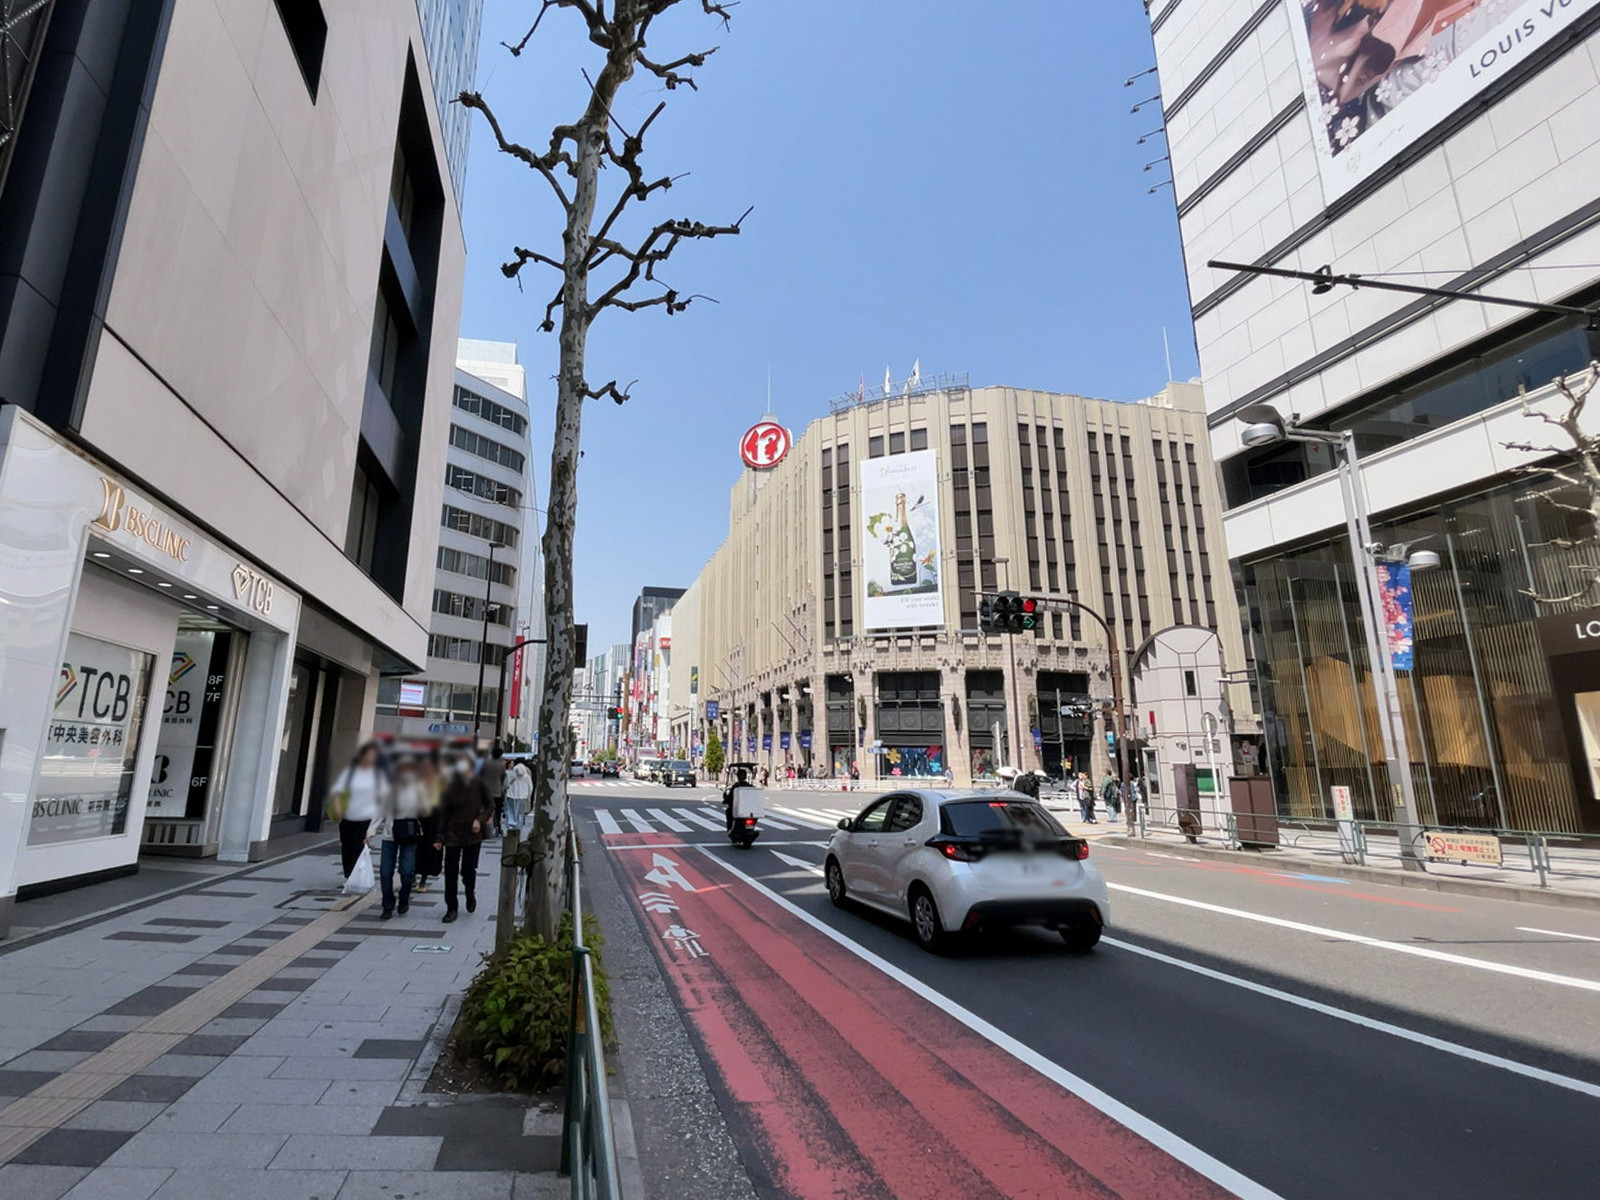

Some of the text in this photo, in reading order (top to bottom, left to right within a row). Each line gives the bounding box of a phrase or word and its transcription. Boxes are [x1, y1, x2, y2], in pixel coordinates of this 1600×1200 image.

[1469, 18, 1535, 78] LOUIS
[247, 571, 274, 616] TCB
[1575, 620, 1600, 639] LO
[208, 675, 224, 685] 8F
[77, 665, 131, 722] TCB
[206, 692, 221, 702] 7F
[191, 777, 207, 787] 6F
